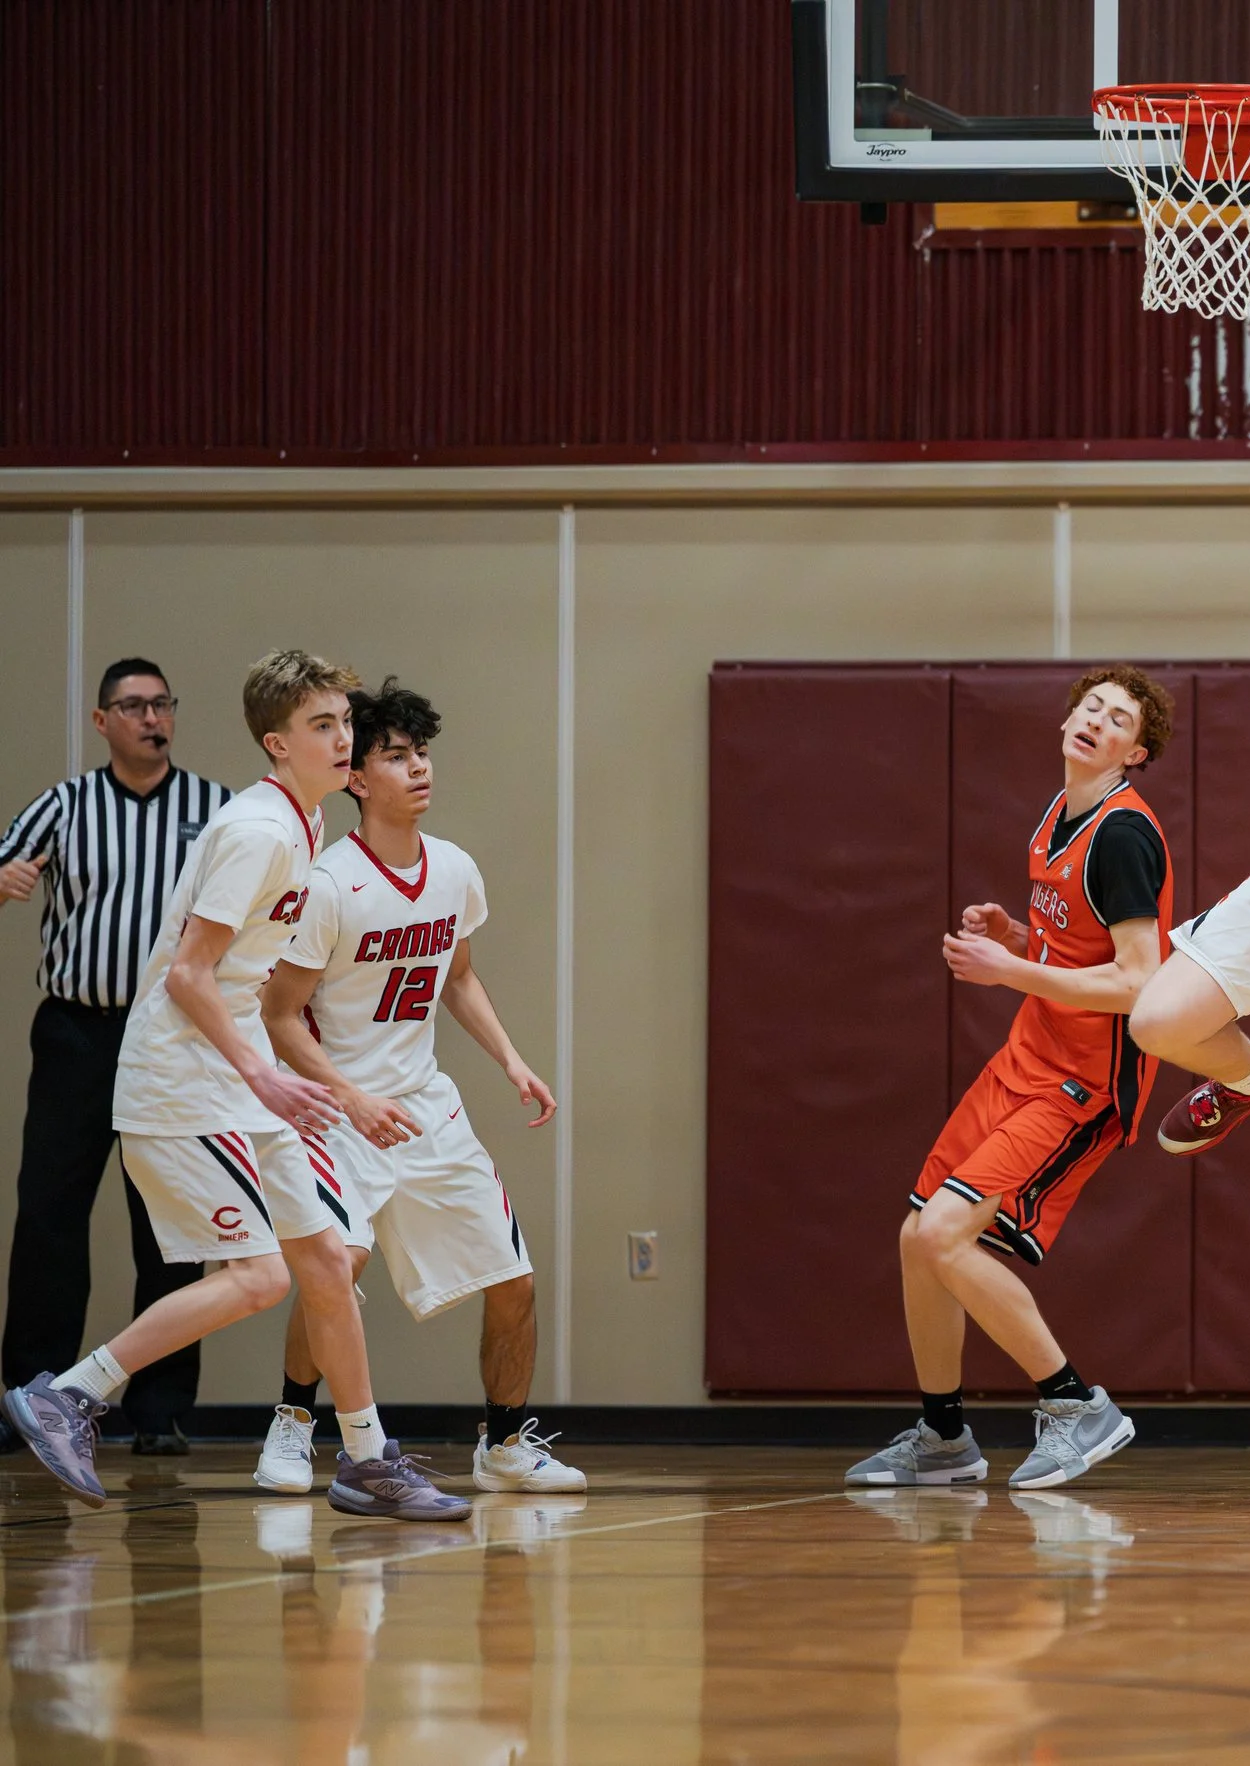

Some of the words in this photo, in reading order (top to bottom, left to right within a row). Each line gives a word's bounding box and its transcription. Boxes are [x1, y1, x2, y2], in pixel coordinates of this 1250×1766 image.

[866, 144, 906, 157] Jaypro
[354, 914, 456, 963] CAMAS
[373, 966, 438, 1022] 12
[211, 1206, 243, 1229] C
